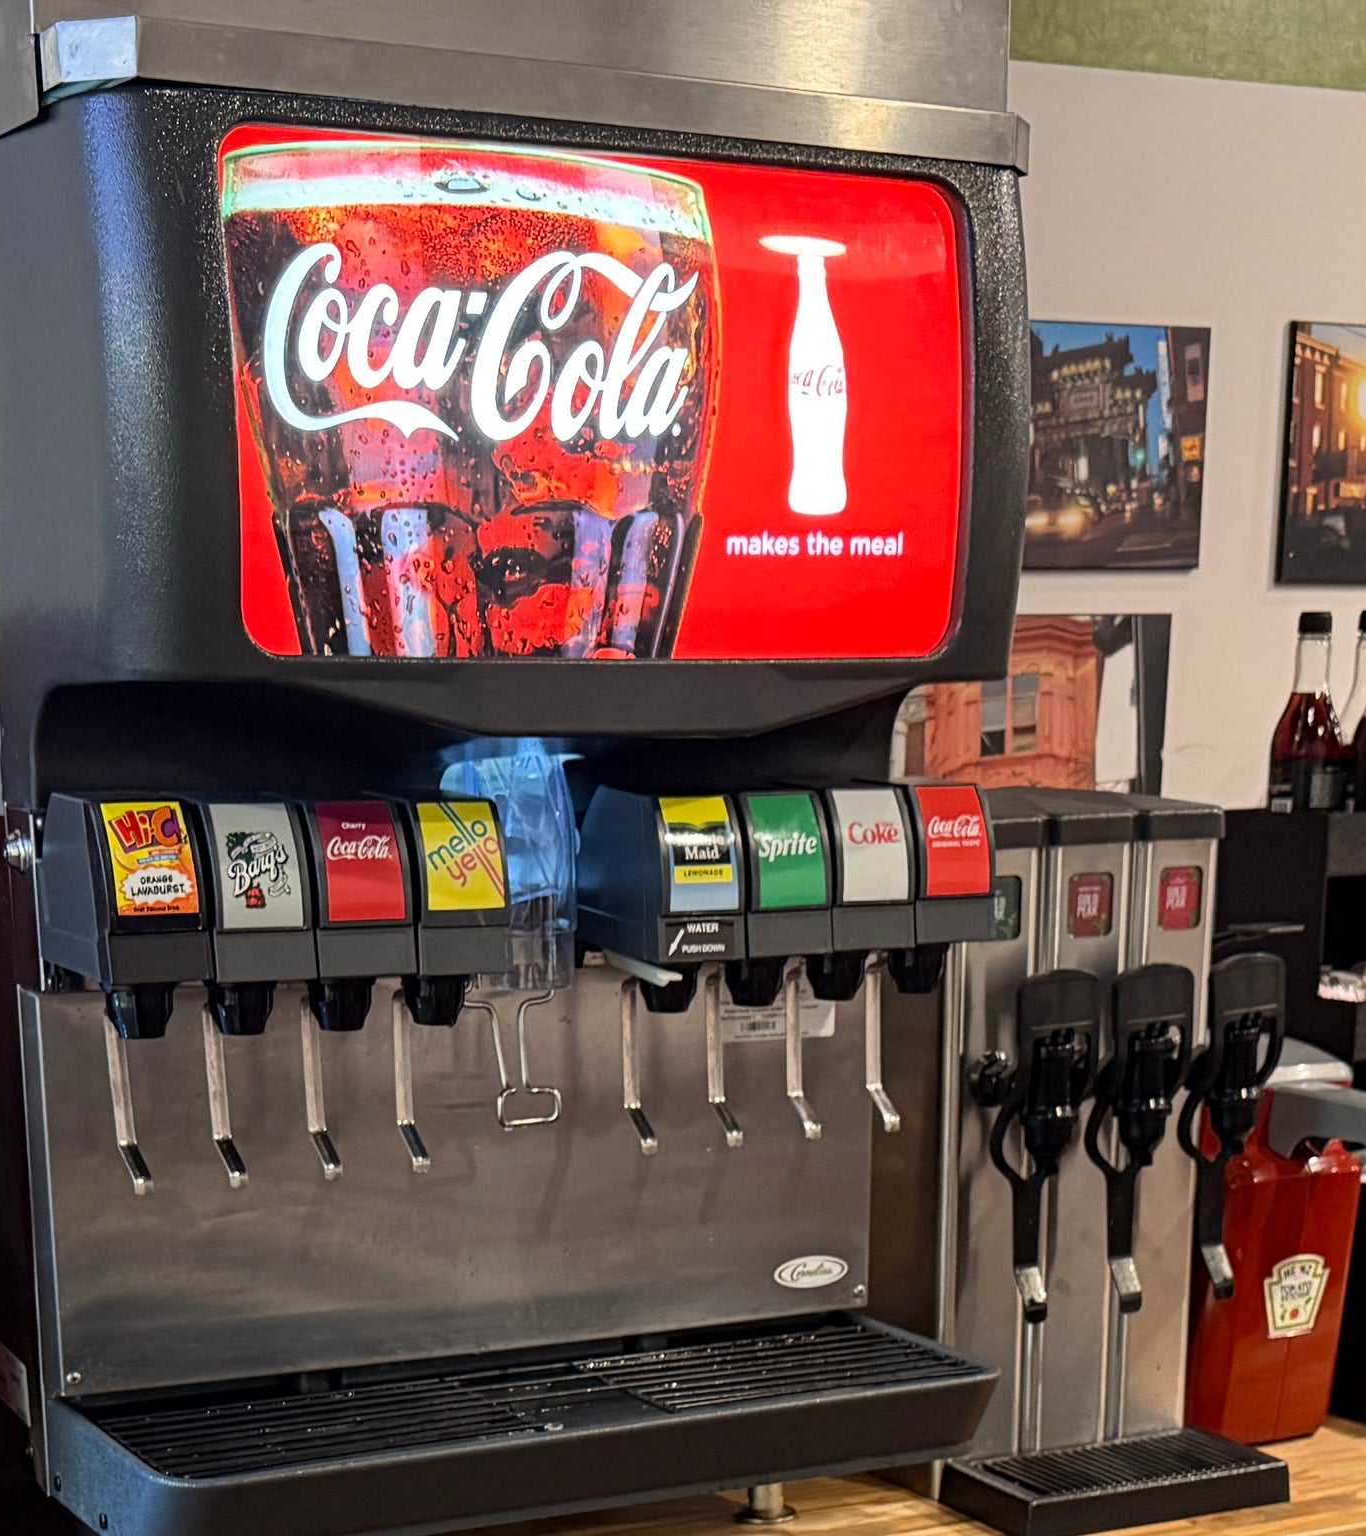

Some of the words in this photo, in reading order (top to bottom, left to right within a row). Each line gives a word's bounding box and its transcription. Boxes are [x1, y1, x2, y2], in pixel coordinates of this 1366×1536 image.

[263, 240, 701, 443] Coca-Cola
[726, 531, 800, 556] makes
[807, 531, 843, 556] the
[850, 531, 905, 556] meal
[112, 805, 179, 850] Hi-C
[341, 822, 366, 831] Cherry
[427, 802, 488, 871] mello
[848, 821, 899, 845] Coke
[928, 813, 982, 839] Coca-Cola
[326, 835, 393, 861] Coca-Cola
[685, 846, 721, 861] Maid
[758, 832, 817, 862] Sprite
[140, 875, 173, 885] ORANGE
[228, 844, 289, 899] Barq's
[446, 836, 505, 899] yello
[687, 922, 719, 933] WATER
[682, 944, 702, 953] PUSH
[703, 943, 725, 953] DOWN
